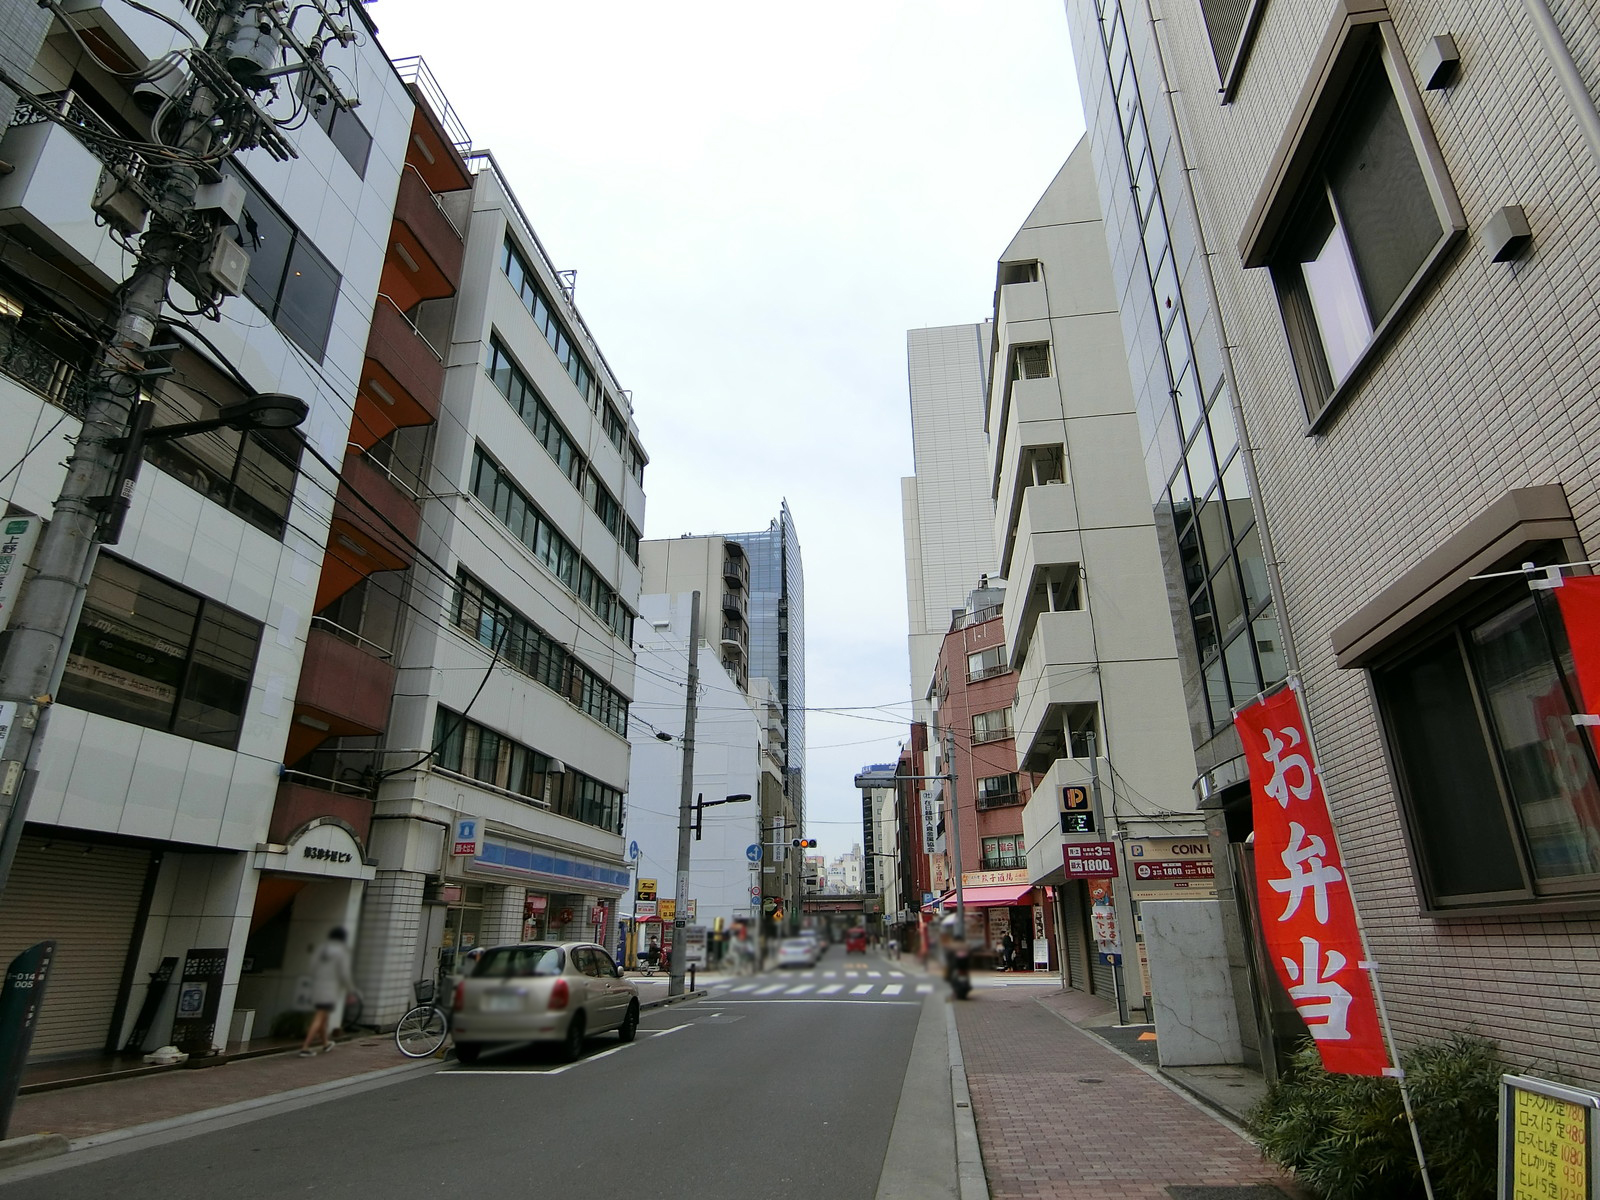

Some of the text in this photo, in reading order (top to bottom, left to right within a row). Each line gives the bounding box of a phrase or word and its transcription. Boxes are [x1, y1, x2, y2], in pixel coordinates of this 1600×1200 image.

[93, 665, 127, 685] Trading
[985, 843, 996, 853] 2F
[1171, 844, 1203, 855] COIN
[1262, 725, 1353, 1040] お弁当
[14, 980, 34, 988] 005
[1566, 1124, 1584, 1145] 980
[1561, 1144, 1583, 1167] 1080
[1563, 1166, 1584, 1188] 930
